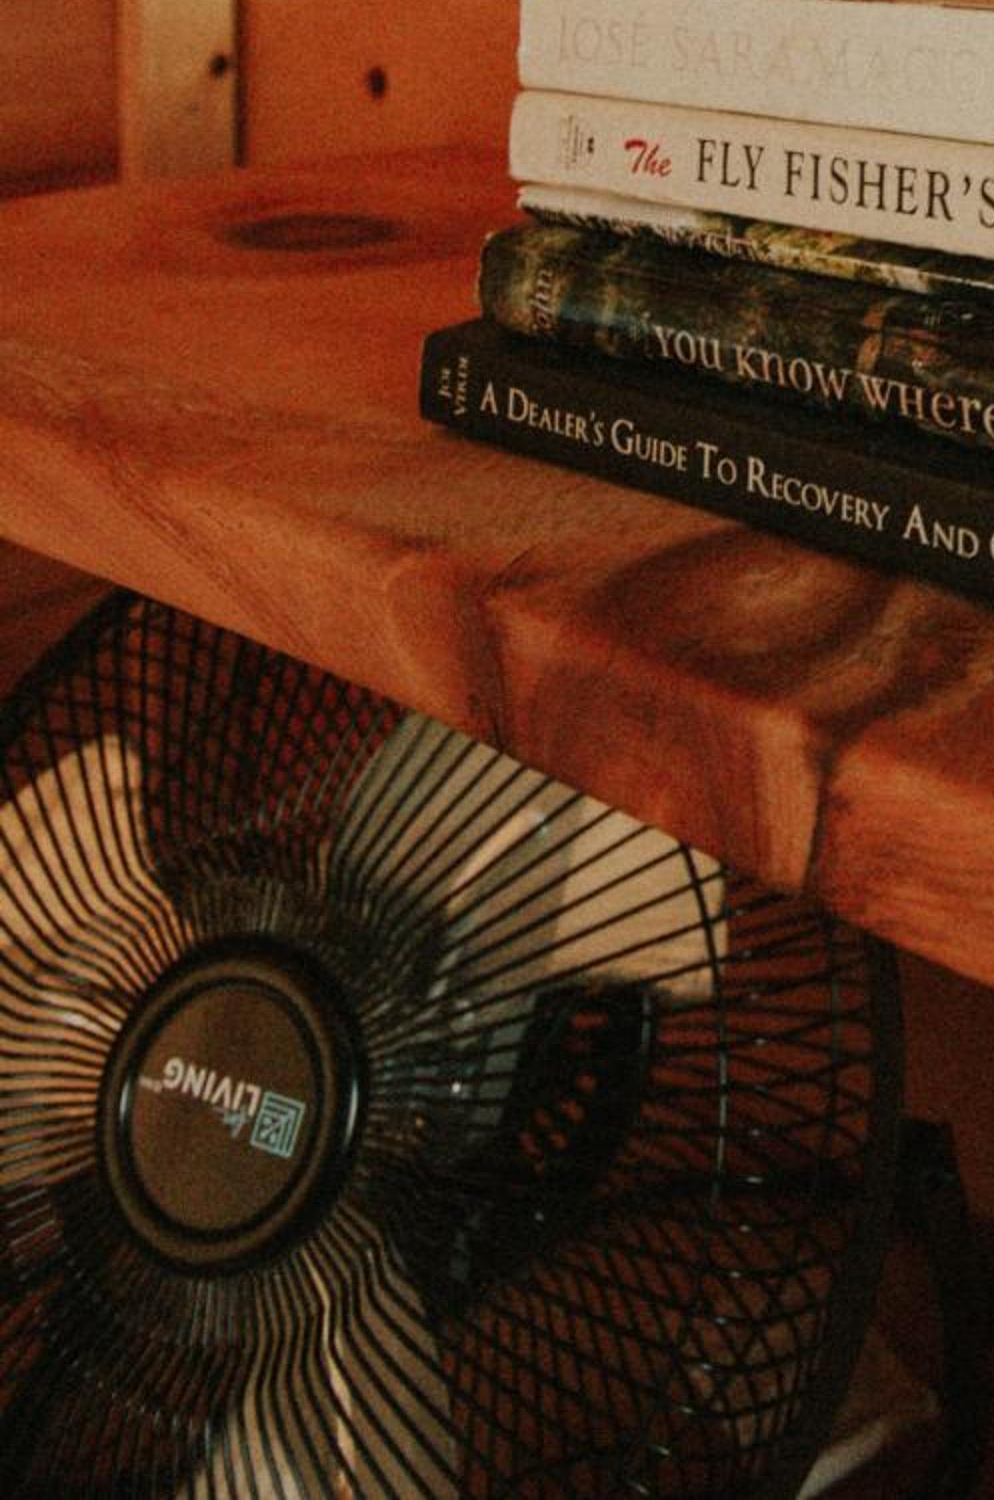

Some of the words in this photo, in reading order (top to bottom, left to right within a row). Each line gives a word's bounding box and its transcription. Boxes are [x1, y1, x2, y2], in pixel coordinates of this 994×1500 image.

[624, 139, 673, 177] The
[697, 138, 764, 191] FLY
[480, 382, 498, 415] A
[610, 419, 688, 472] GUIDE
[696, 441, 737, 486] TO
[747, 455, 890, 531] RECOVERY
[903, 505, 980, 560] AND
[163, 1056, 261, 1117] LIVING
